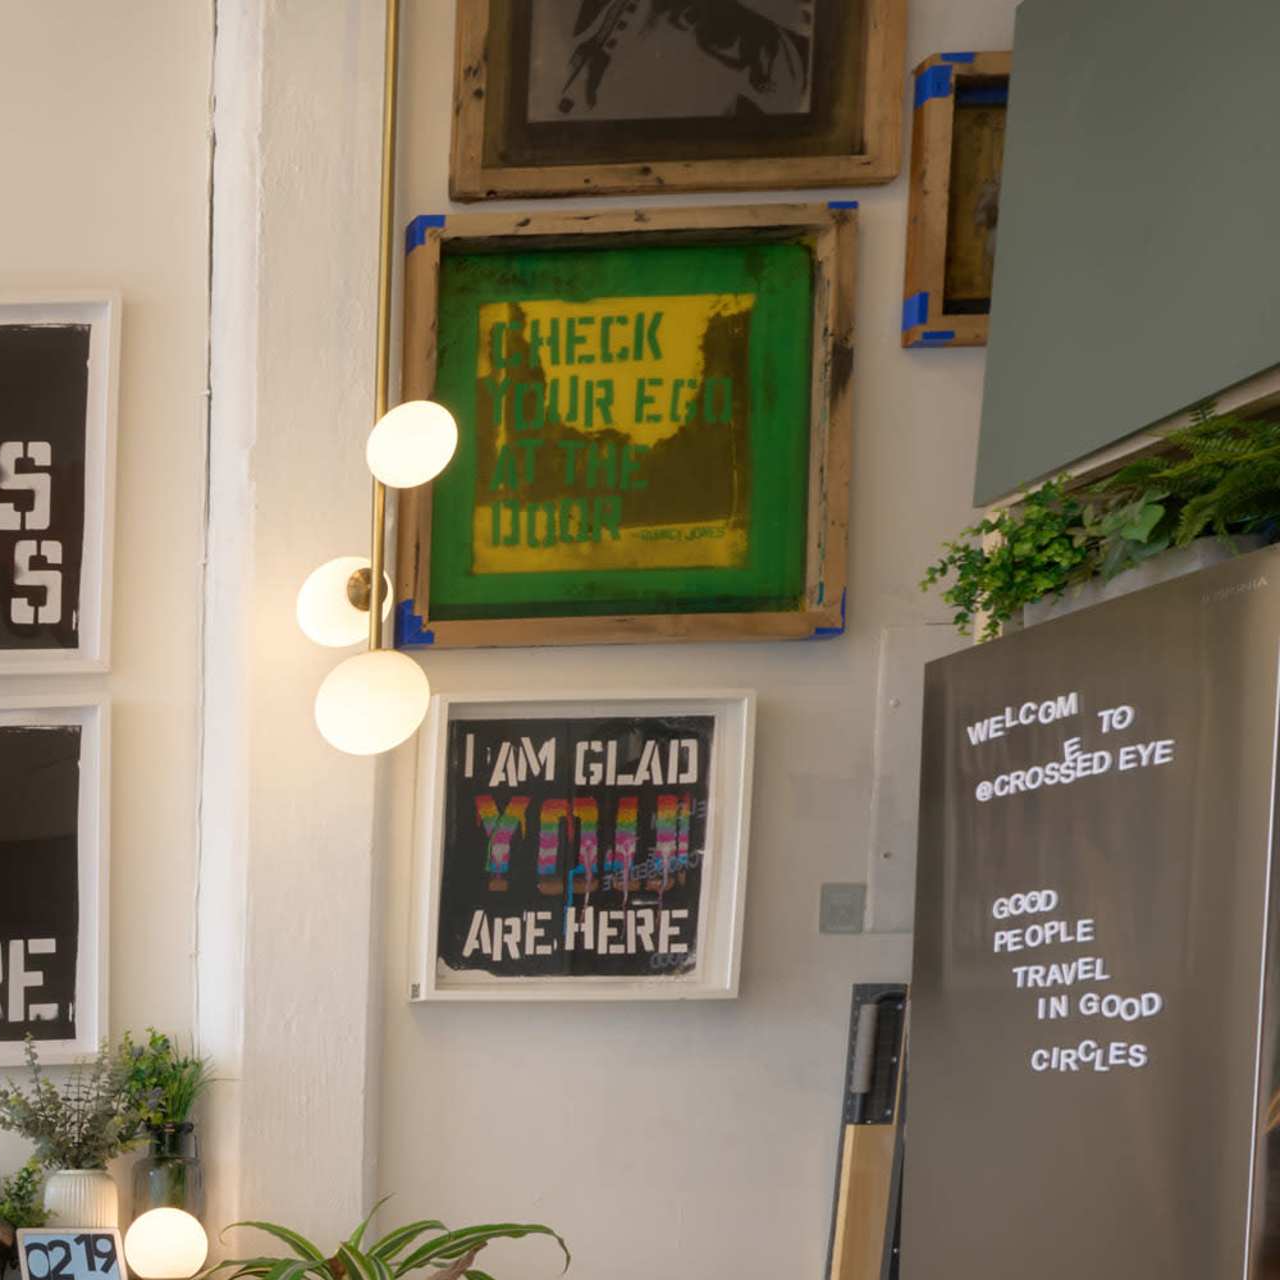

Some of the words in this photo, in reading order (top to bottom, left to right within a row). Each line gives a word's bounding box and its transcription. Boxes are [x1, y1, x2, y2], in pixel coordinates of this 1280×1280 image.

[492, 312, 663, 370] CHECK
[484, 376, 616, 431] YOUR
[634, 377, 733, 424] EGO
[490, 440, 540, 492] AT
[560, 443, 650, 489] THE
[490, 495, 622, 549] DOOR
[1097, 705, 1135, 734] TO
[465, 734, 474, 779] I
[489, 736, 556, 788] AM
[574, 739, 699, 787] GLAD
[975, 750, 1112, 802] @CROSSED
[1118, 739, 1174, 771] EYE
[475, 793, 693, 895] YOU
[993, 889, 1058, 920] GOOD
[462, 910, 555, 961] ARE
[565, 906, 688, 956] HERE
[994, 918, 1095, 953] PEOPLE
[1013, 957, 1110, 988] TRAVEL
[1037, 996, 1068, 1020] IN
[1079, 991, 1163, 1021] GOOD
[1031, 1039, 1148, 1072] CIRCLES
